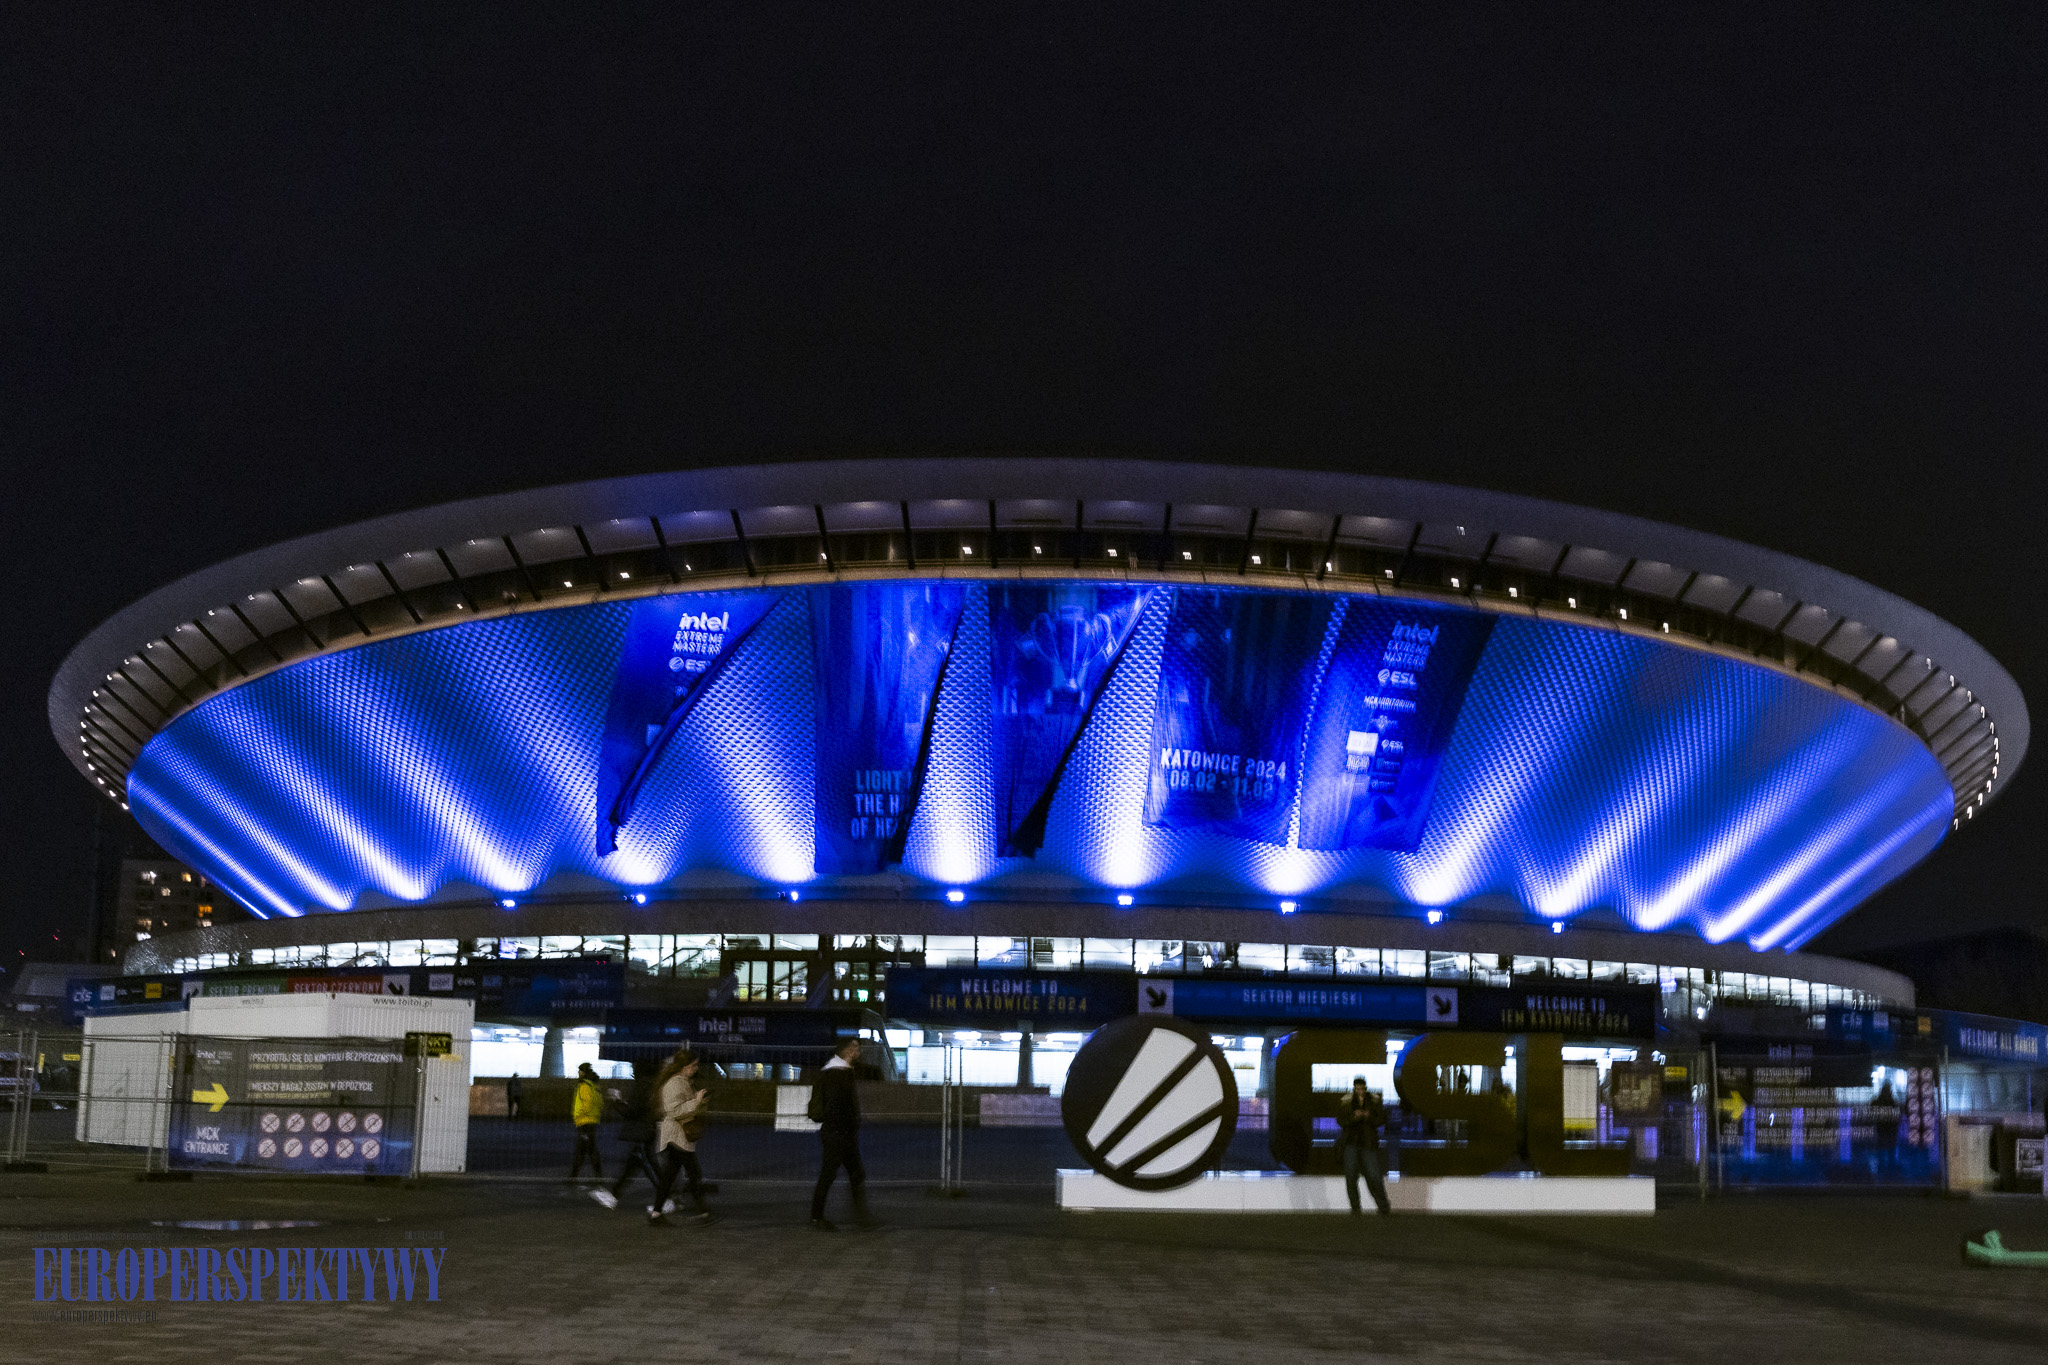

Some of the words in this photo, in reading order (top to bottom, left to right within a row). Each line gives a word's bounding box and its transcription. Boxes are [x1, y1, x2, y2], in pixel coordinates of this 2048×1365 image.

[679, 611, 729, 632] intel
[675, 631, 724, 645] EXTREME
[1392, 620, 1440, 646] intel
[672, 641, 722, 655] MASTERS
[1387, 640, 1430, 656] EXTREME
[1383, 651, 1428, 669] MASTERS
[1390, 670, 1417, 687] ESL
[1161, 748, 1240, 776] KATOWICE
[1245, 757, 1286, 784] 2024
[855, 769, 902, 793] LIGHT
[1170, 769, 1216, 793] 08.02
[853, 793, 884, 816] THE
[851, 817, 869, 840] OF
[293, 982, 329, 994] SEKTOR
[330, 980, 381, 993] CZERWONY
[961, 978, 1032, 996] WELCOME
[1040, 979, 1058, 997] TO
[930, 993, 956, 1009] IEM
[964, 994, 1039, 1011] KATOWICE
[1047, 995, 1087, 1013] 2024
[1243, 988, 1293, 1004] SEKTOR
[1298, 990, 1362, 1006] NIEBIESKI
[1526, 995, 1585, 1012] WELCOME
[1591, 997, 1606, 1014] TO
[698, 1016, 733, 1033] intel
[1500, 1008, 1525, 1027] IEM
[1530, 1010, 1592, 1029] KATOWICE
[1959, 1027, 1998, 1051] WELCOME
[1271, 1028, 1630, 1177] ESL
[196, 1126, 220, 1141] MCK
[183, 1141, 230, 1156] ENTRANCE
